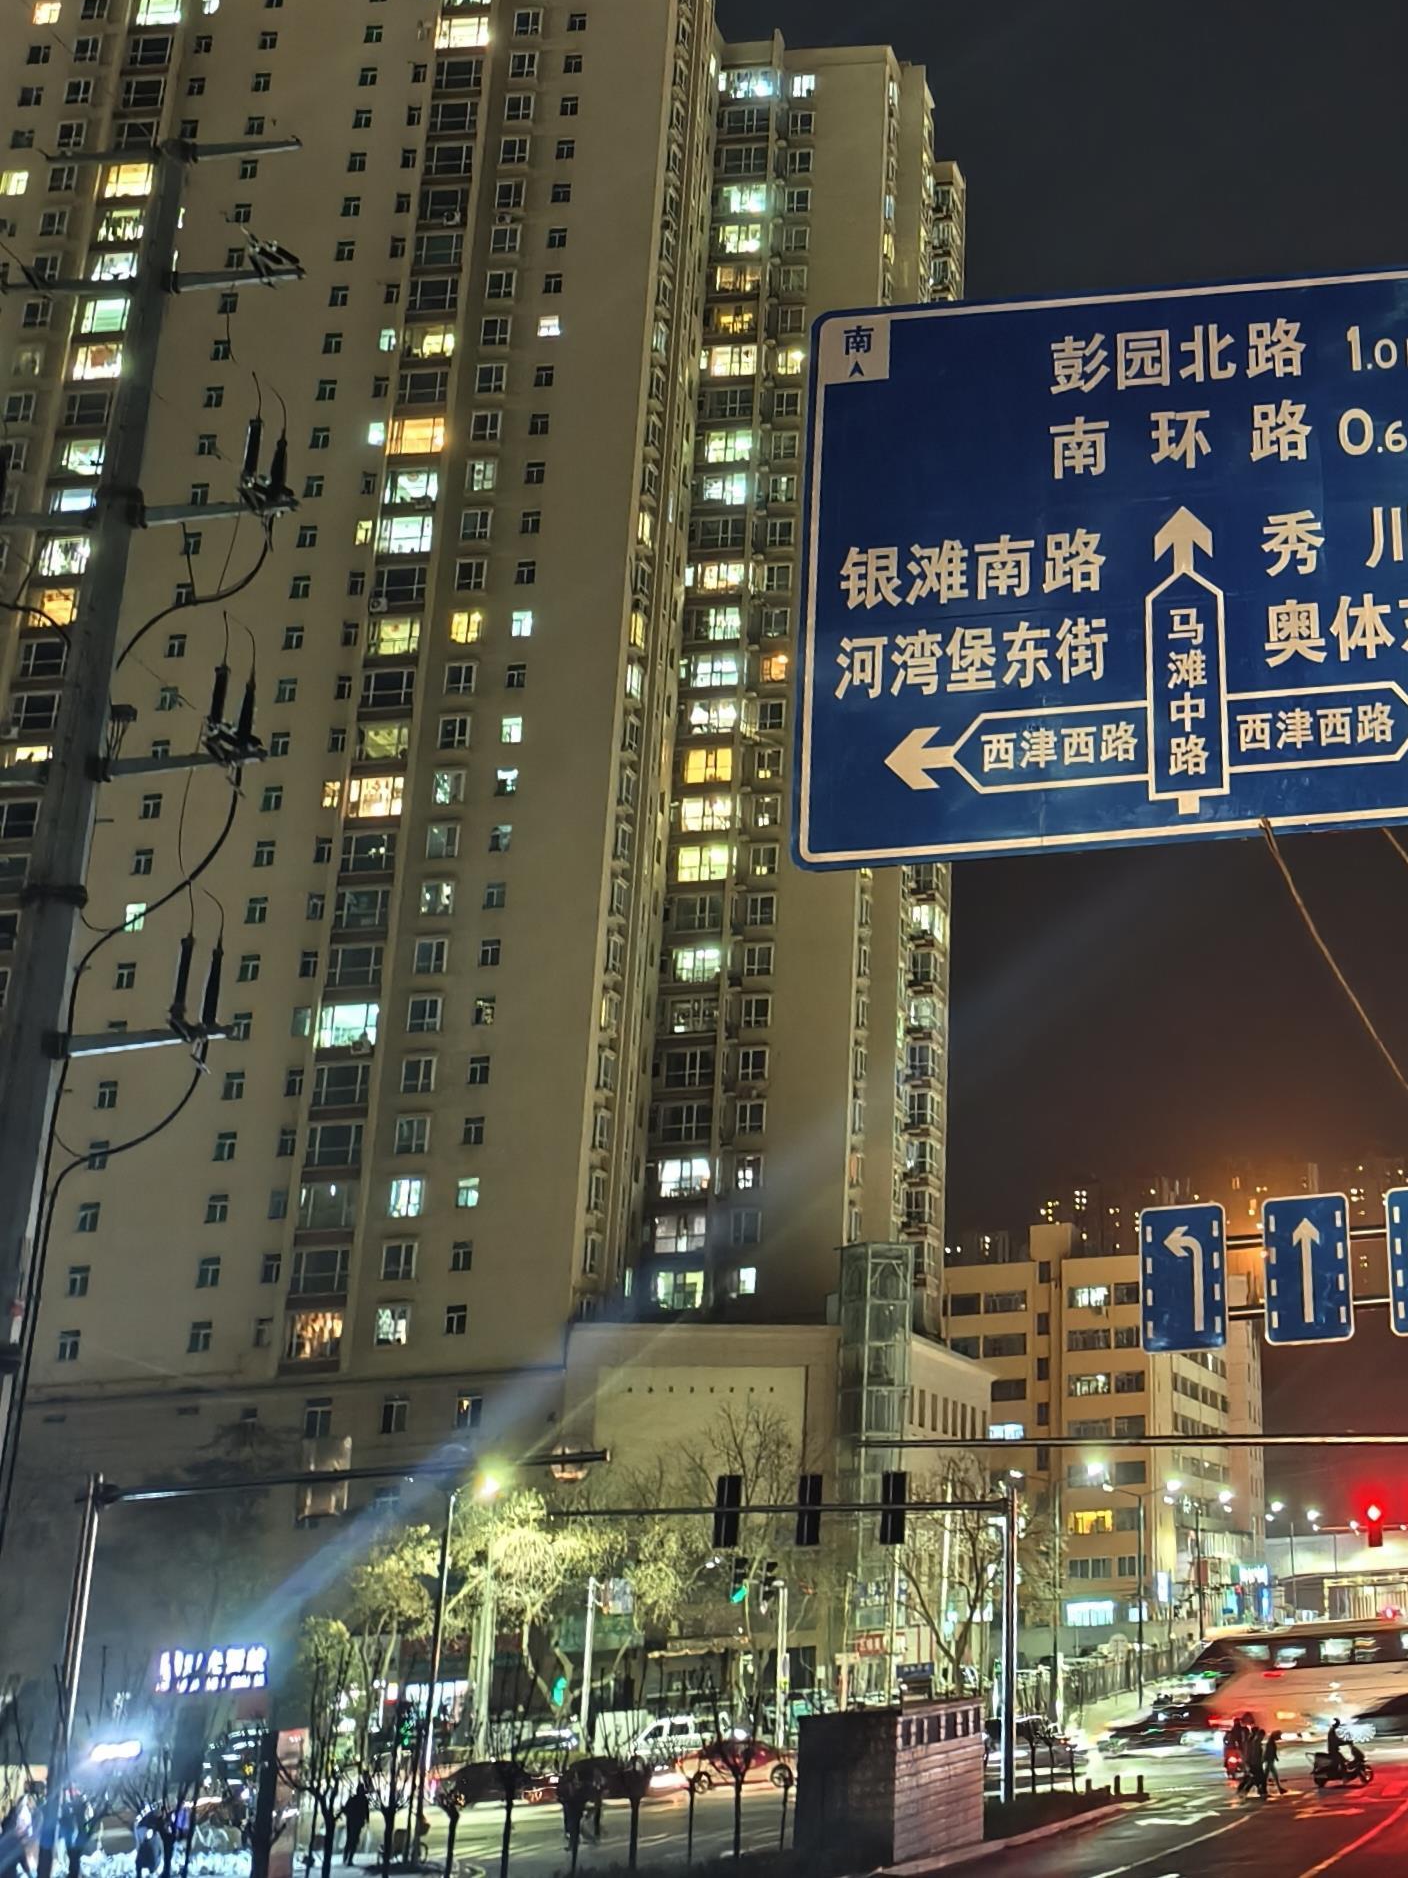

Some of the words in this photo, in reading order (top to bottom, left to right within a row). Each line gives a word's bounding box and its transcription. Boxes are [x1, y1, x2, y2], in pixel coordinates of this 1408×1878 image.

[843, 325, 874, 355] 南
[1050, 318, 1307, 395] 彭园北路
[1049, 399, 1313, 480] 南环路
[840, 528, 1107, 609] 银滩南路
[834, 617, 1109, 700] 河湾堡东街
[1166, 608, 1209, 776] 马滩中路
[980, 721, 1137, 772] 西津西路
[1238, 701, 1395, 753] 西津西路
